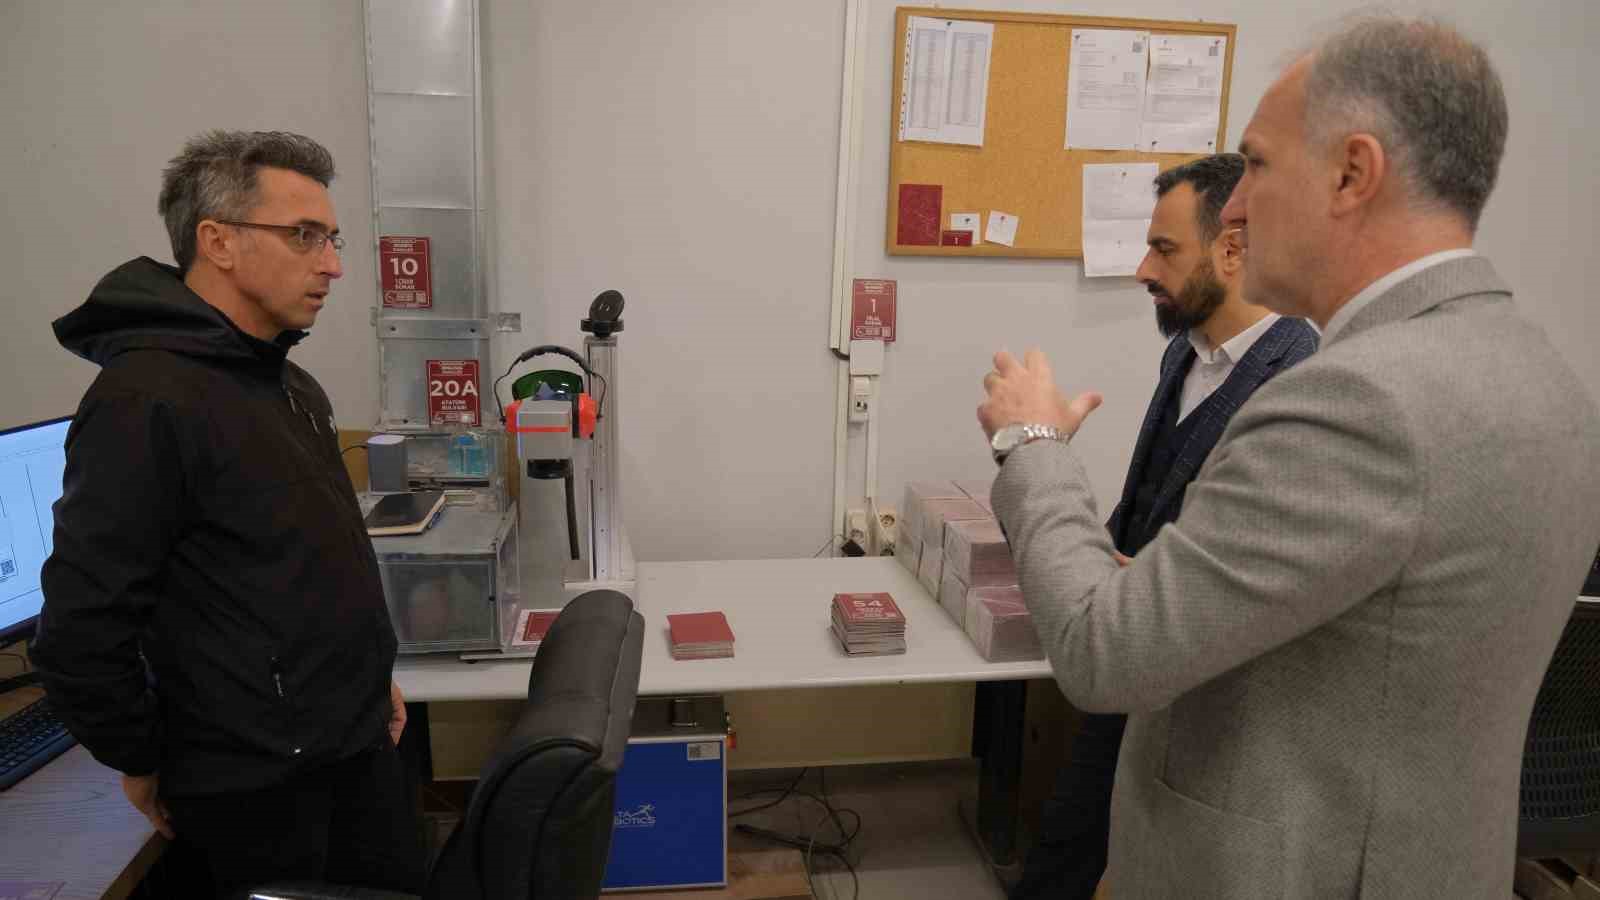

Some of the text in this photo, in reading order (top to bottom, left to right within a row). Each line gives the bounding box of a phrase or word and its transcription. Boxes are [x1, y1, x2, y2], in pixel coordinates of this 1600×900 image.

[390, 257, 418, 275] 10
[871, 298, 876, 312] 1
[431, 380, 478, 396] 20A
